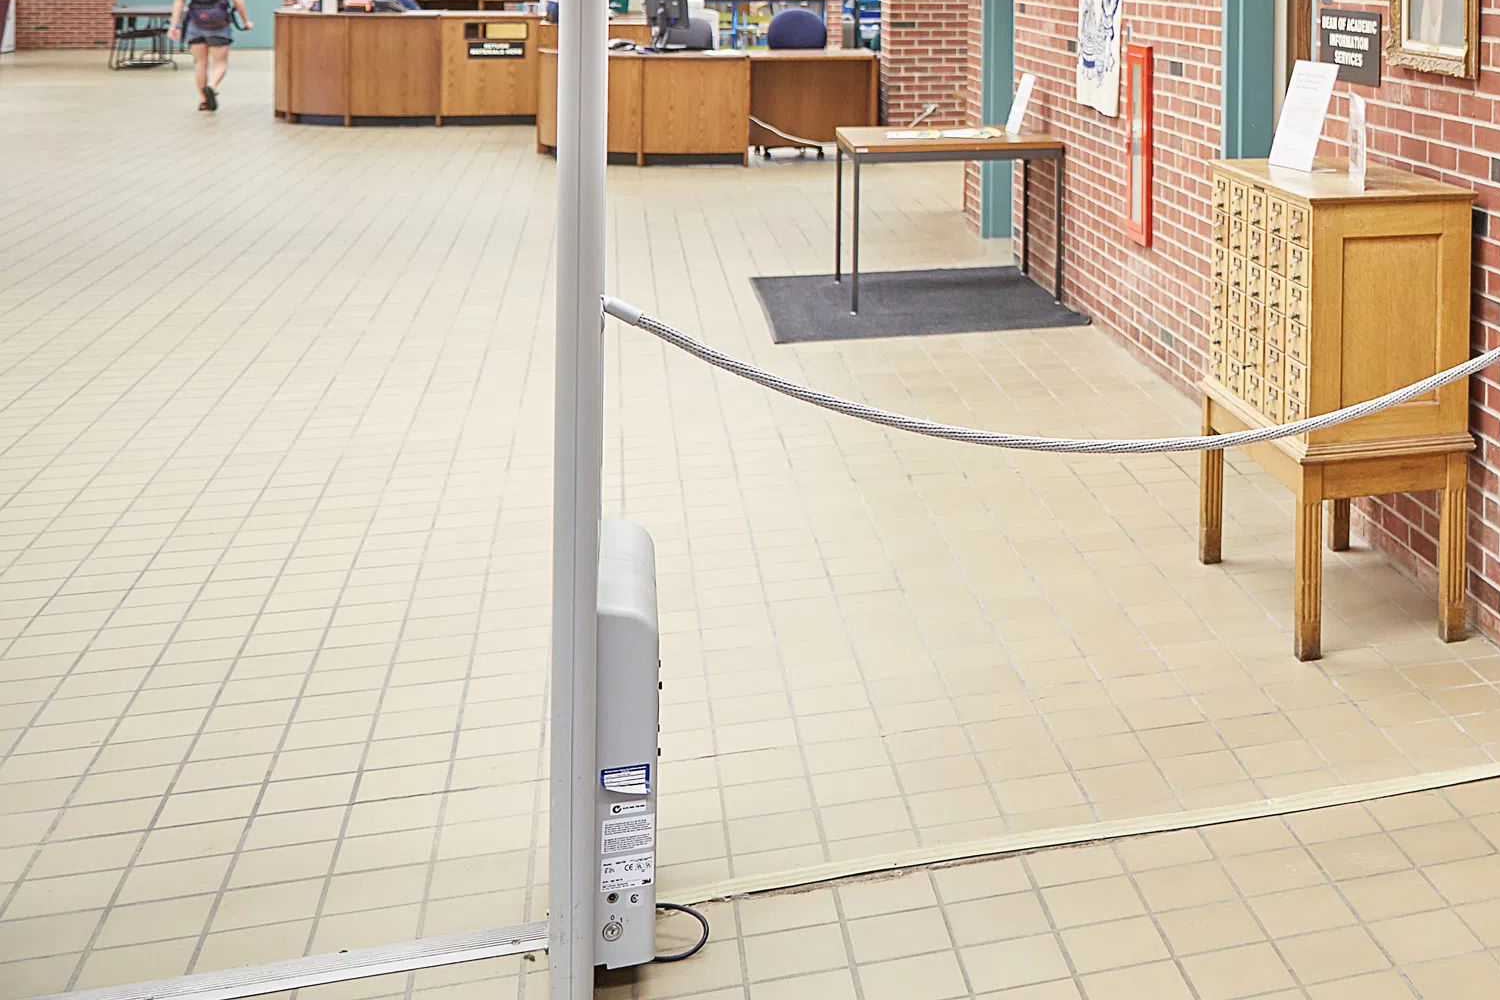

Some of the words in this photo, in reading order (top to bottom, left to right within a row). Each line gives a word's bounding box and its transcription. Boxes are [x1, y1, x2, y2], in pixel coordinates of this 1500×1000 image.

[1321, 15, 1338, 30] DEAN
[1338, 16, 1347, 31] OF
[1347, 17, 1378, 35] ACADEMIC
[1329, 33, 1369, 51] INFORMATION
[1334, 50, 1363, 67] SERVICES
